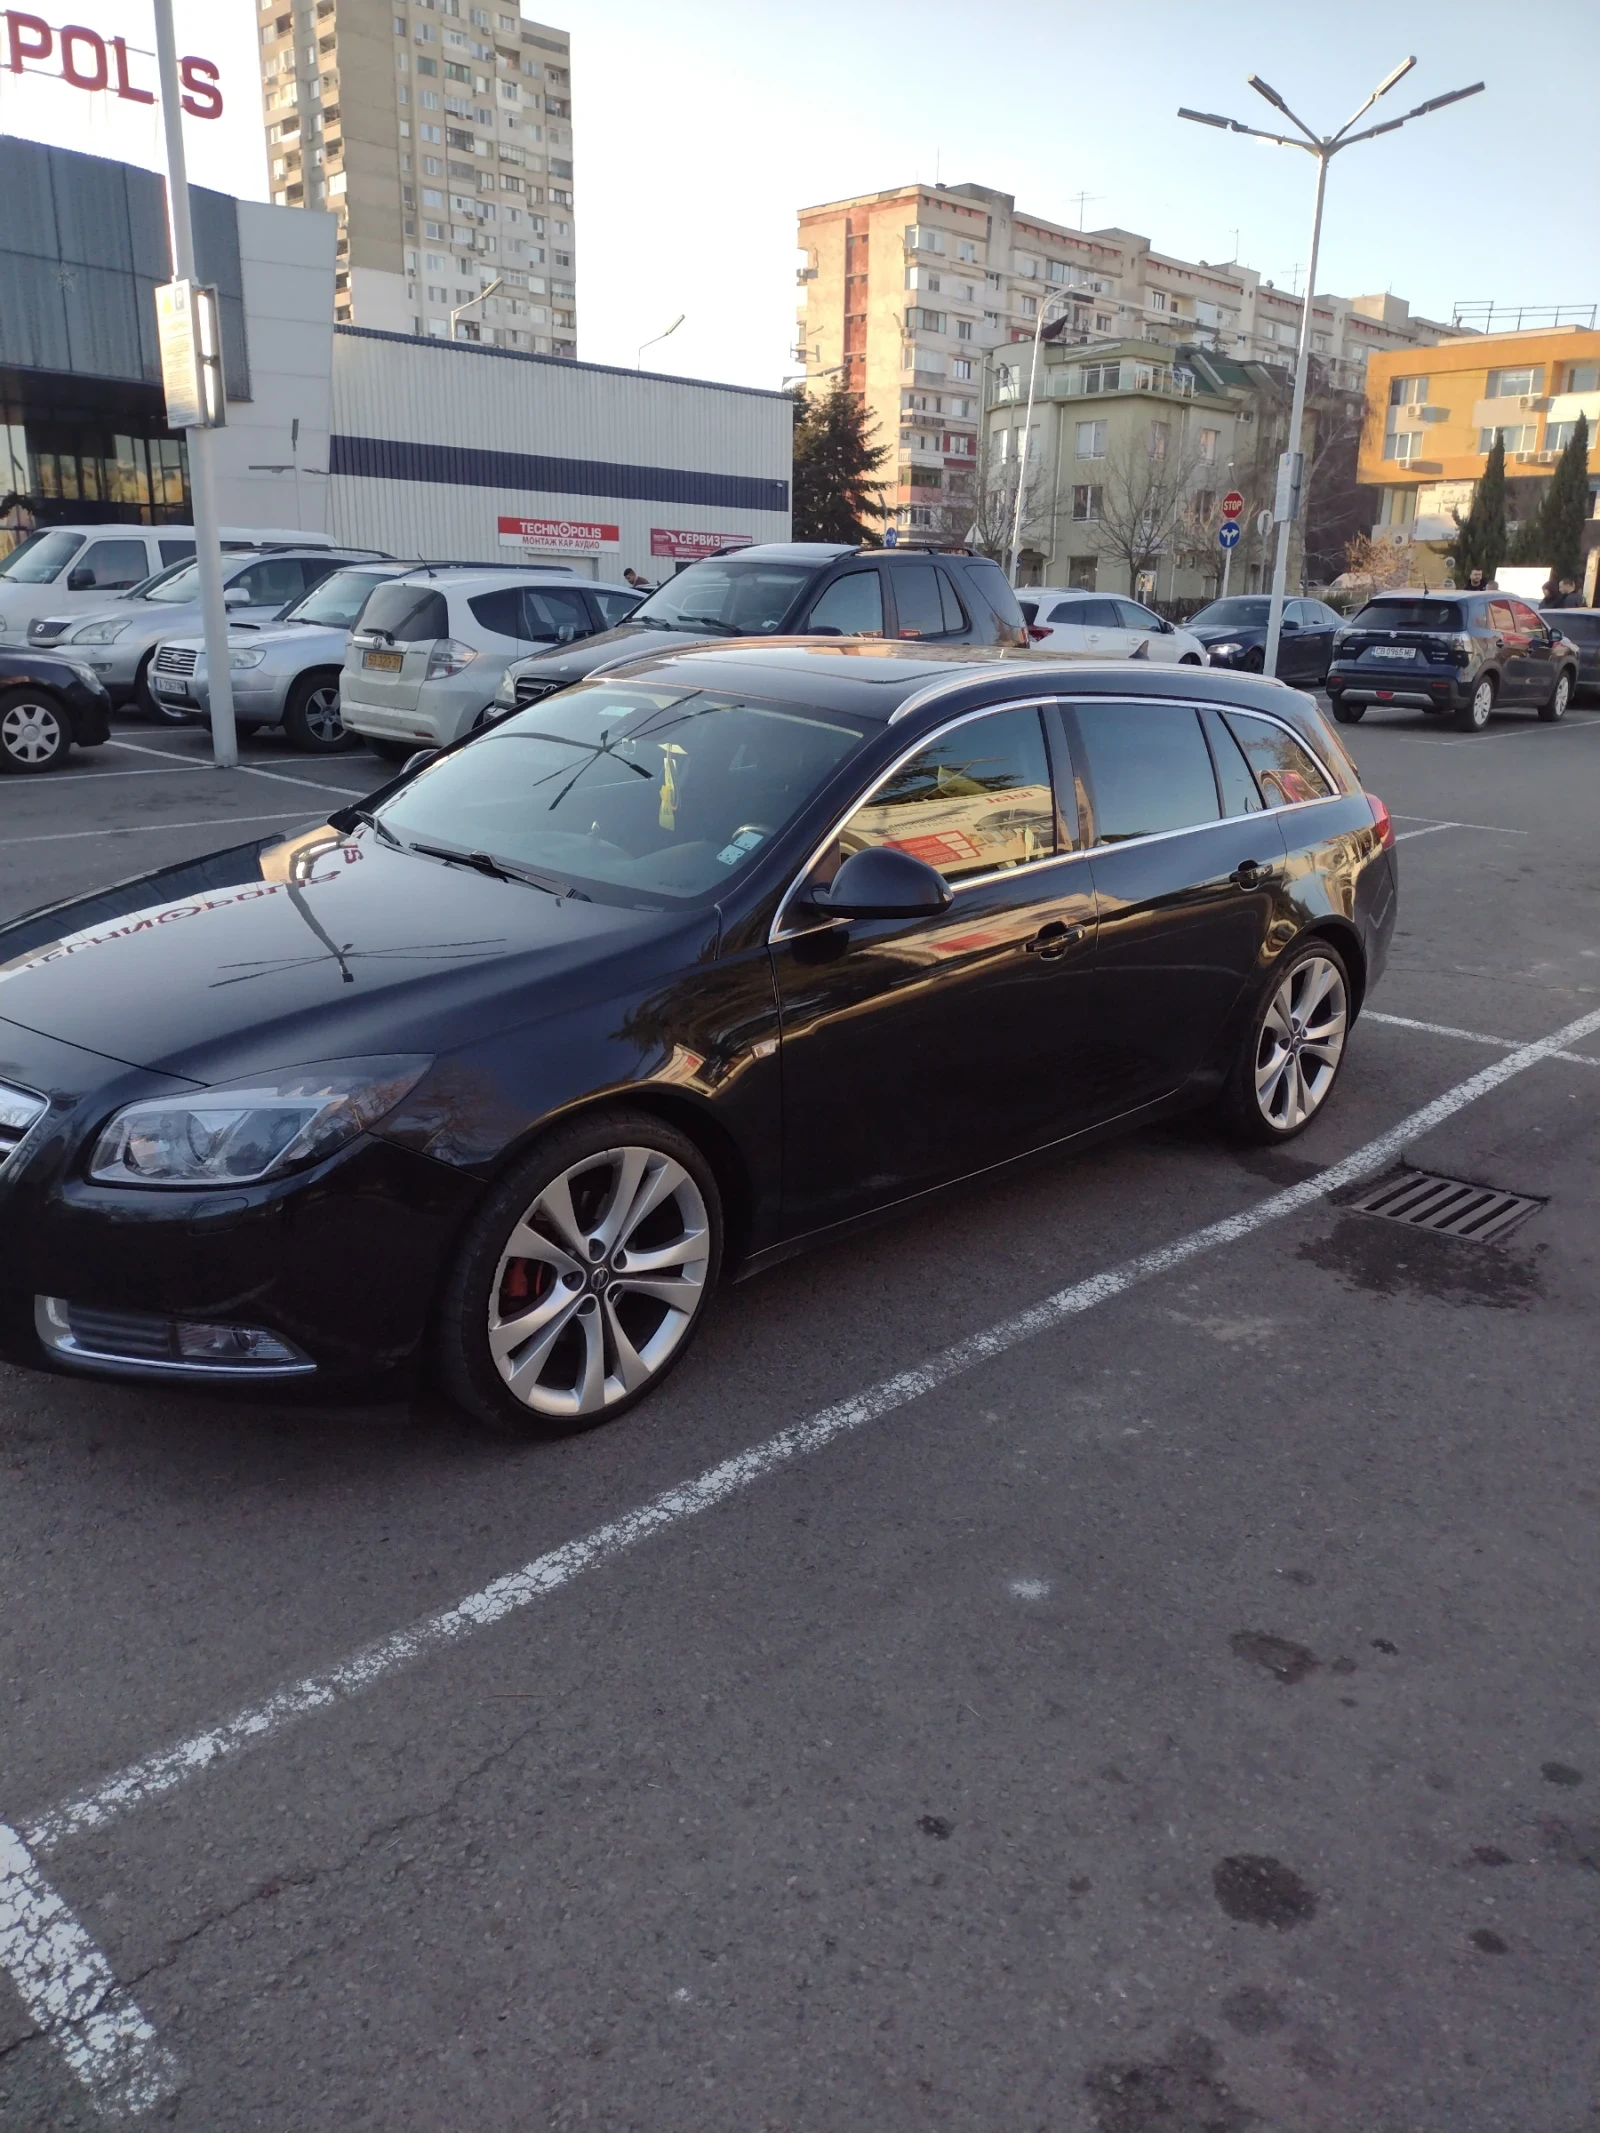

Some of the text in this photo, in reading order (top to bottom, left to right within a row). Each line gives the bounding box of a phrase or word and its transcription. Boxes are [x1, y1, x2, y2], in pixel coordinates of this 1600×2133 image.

[5, 9, 224, 120] POLS
[1223, 500, 1242, 511] STOP
[519, 522, 602, 539] TECHNOPOLIS
[522, 536, 600, 550] МОНТАЖ КАР АУДИО
[678, 533, 721, 547] СЕРВИЗ
